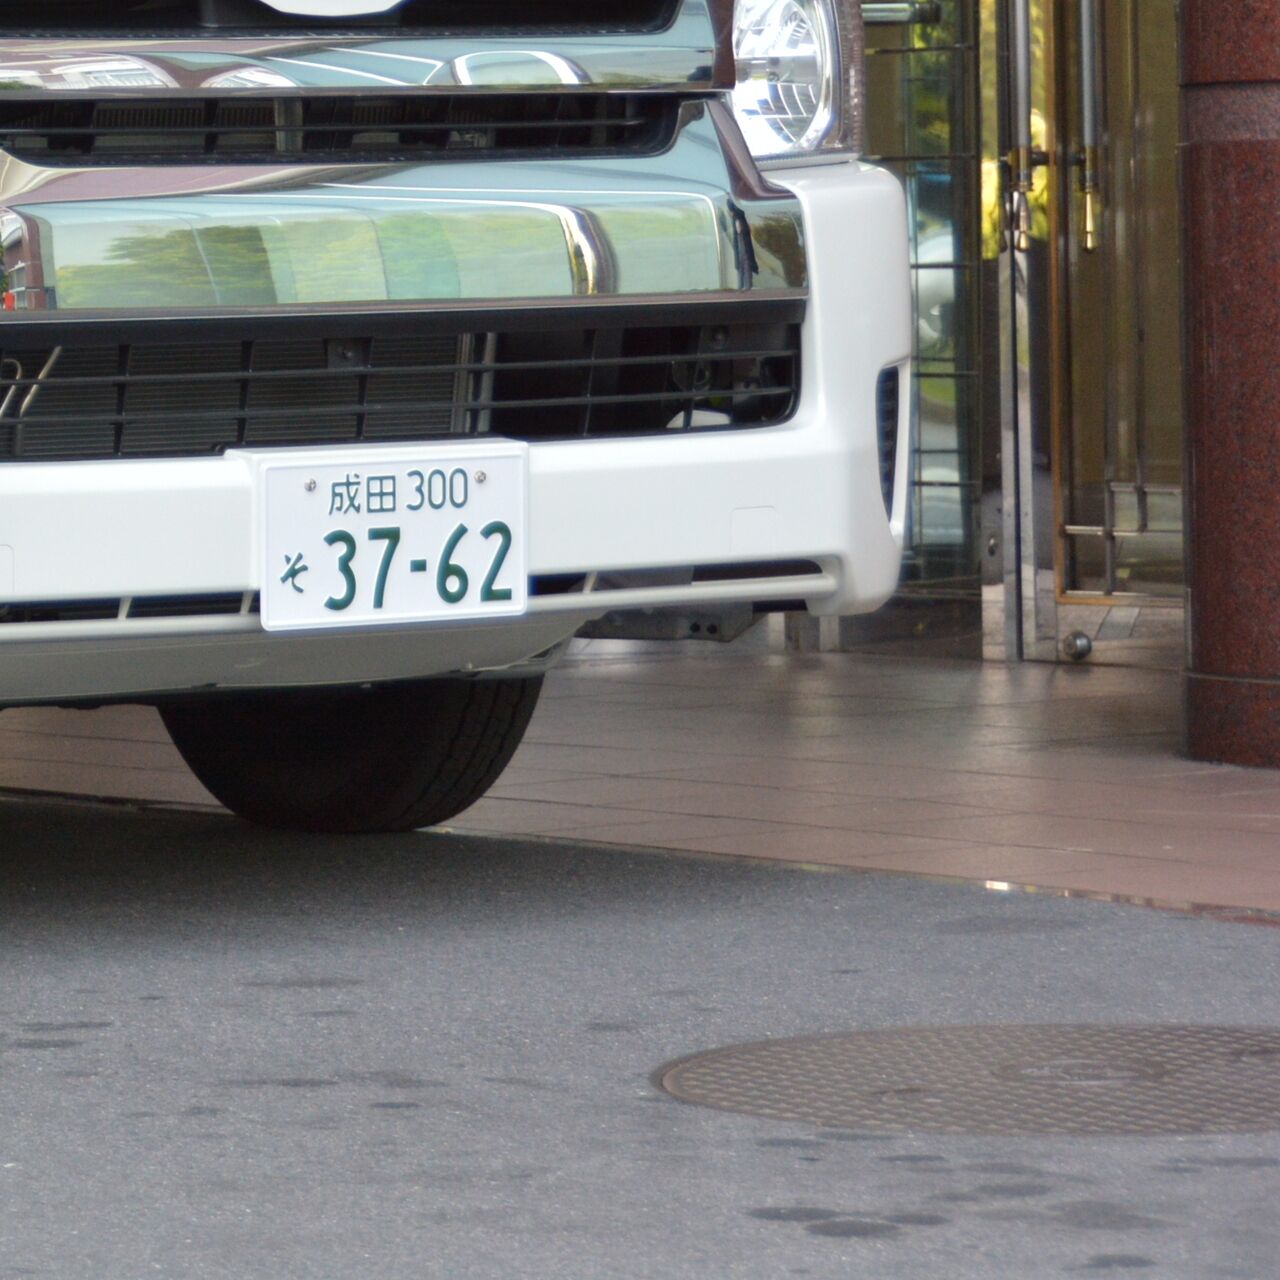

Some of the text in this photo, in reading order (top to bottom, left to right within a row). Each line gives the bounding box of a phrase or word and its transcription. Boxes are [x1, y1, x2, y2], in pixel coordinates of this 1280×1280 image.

[329, 468, 469, 515] 成田 300
[279, 520, 513, 611] そ 37-62
